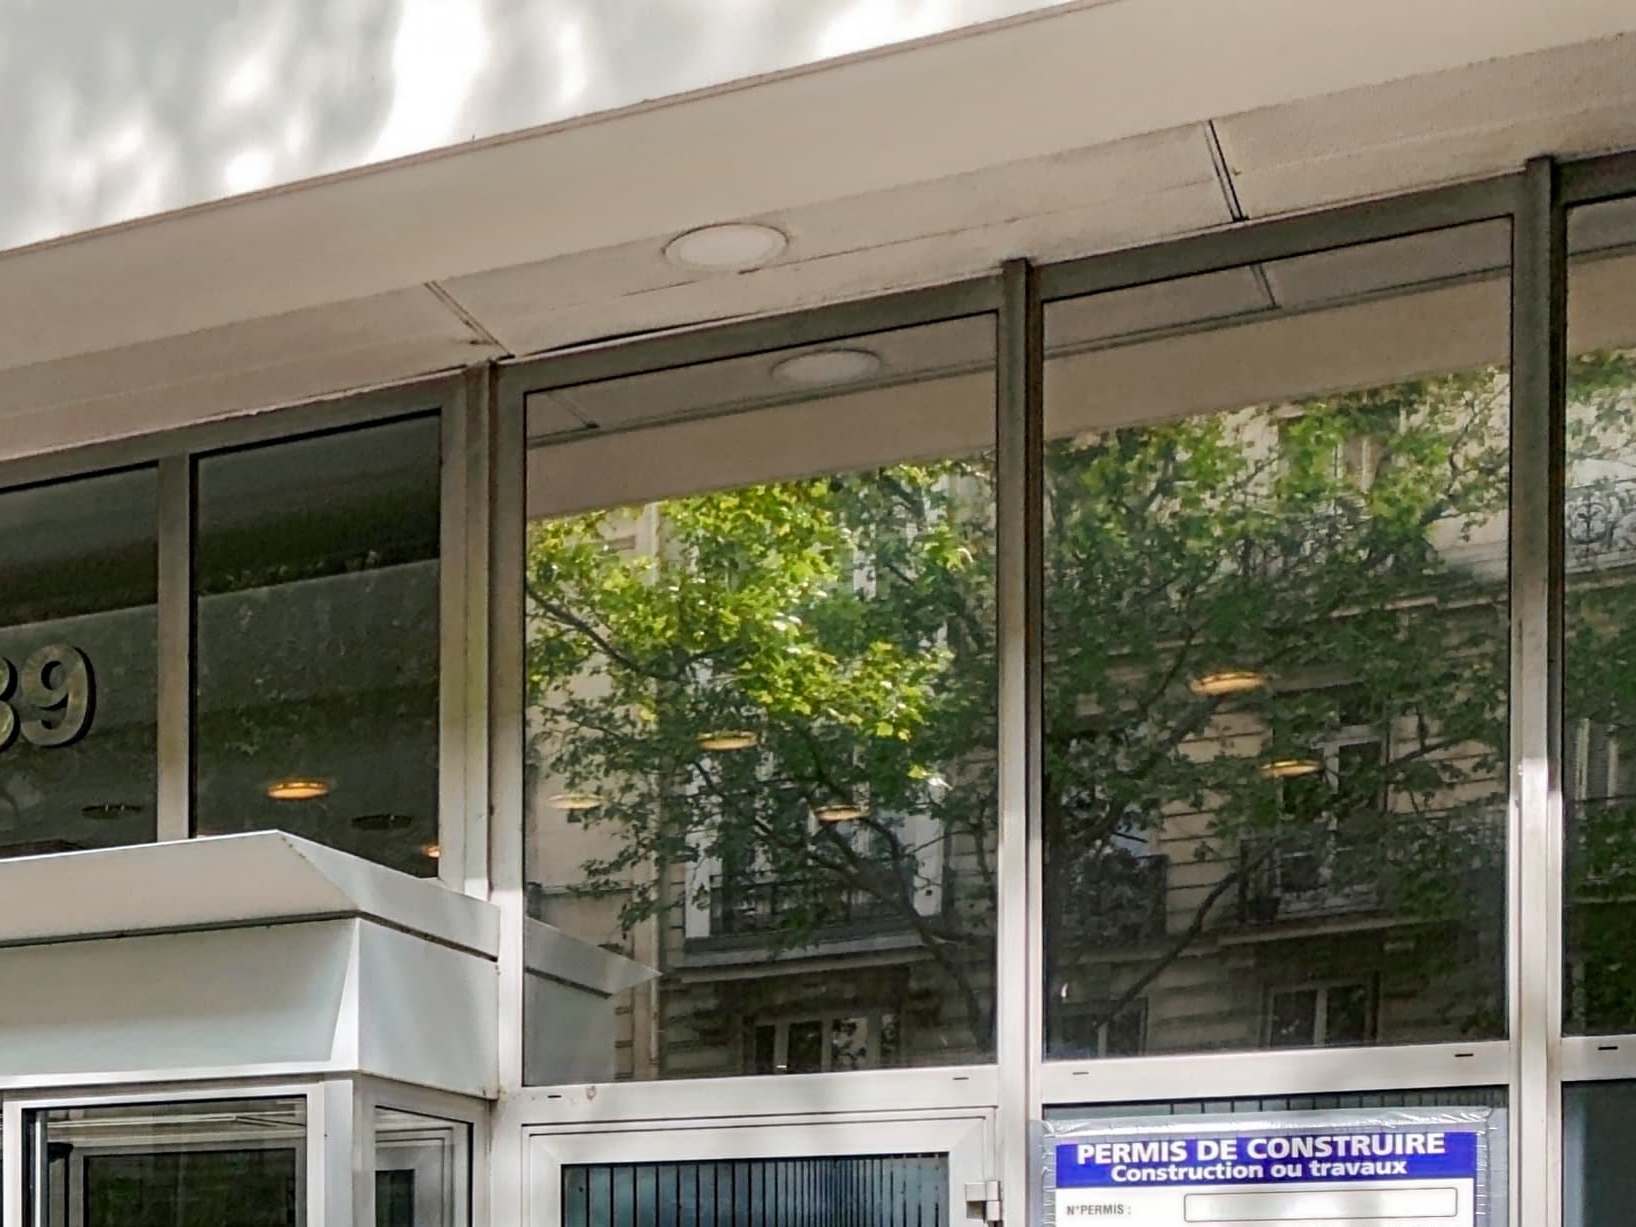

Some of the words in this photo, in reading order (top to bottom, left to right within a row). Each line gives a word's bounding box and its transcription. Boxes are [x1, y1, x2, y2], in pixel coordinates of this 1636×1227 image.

[1077, 1140, 1188, 1164] PERMIS
[1197, 1139, 1238, 1161] DE
[1247, 1133, 1445, 1159] CONSTRUIRE
[1111, 1162, 1264, 1182] Construction
[1271, 1164, 1302, 1177] ou
[1309, 1160, 1407, 1176] travaux
